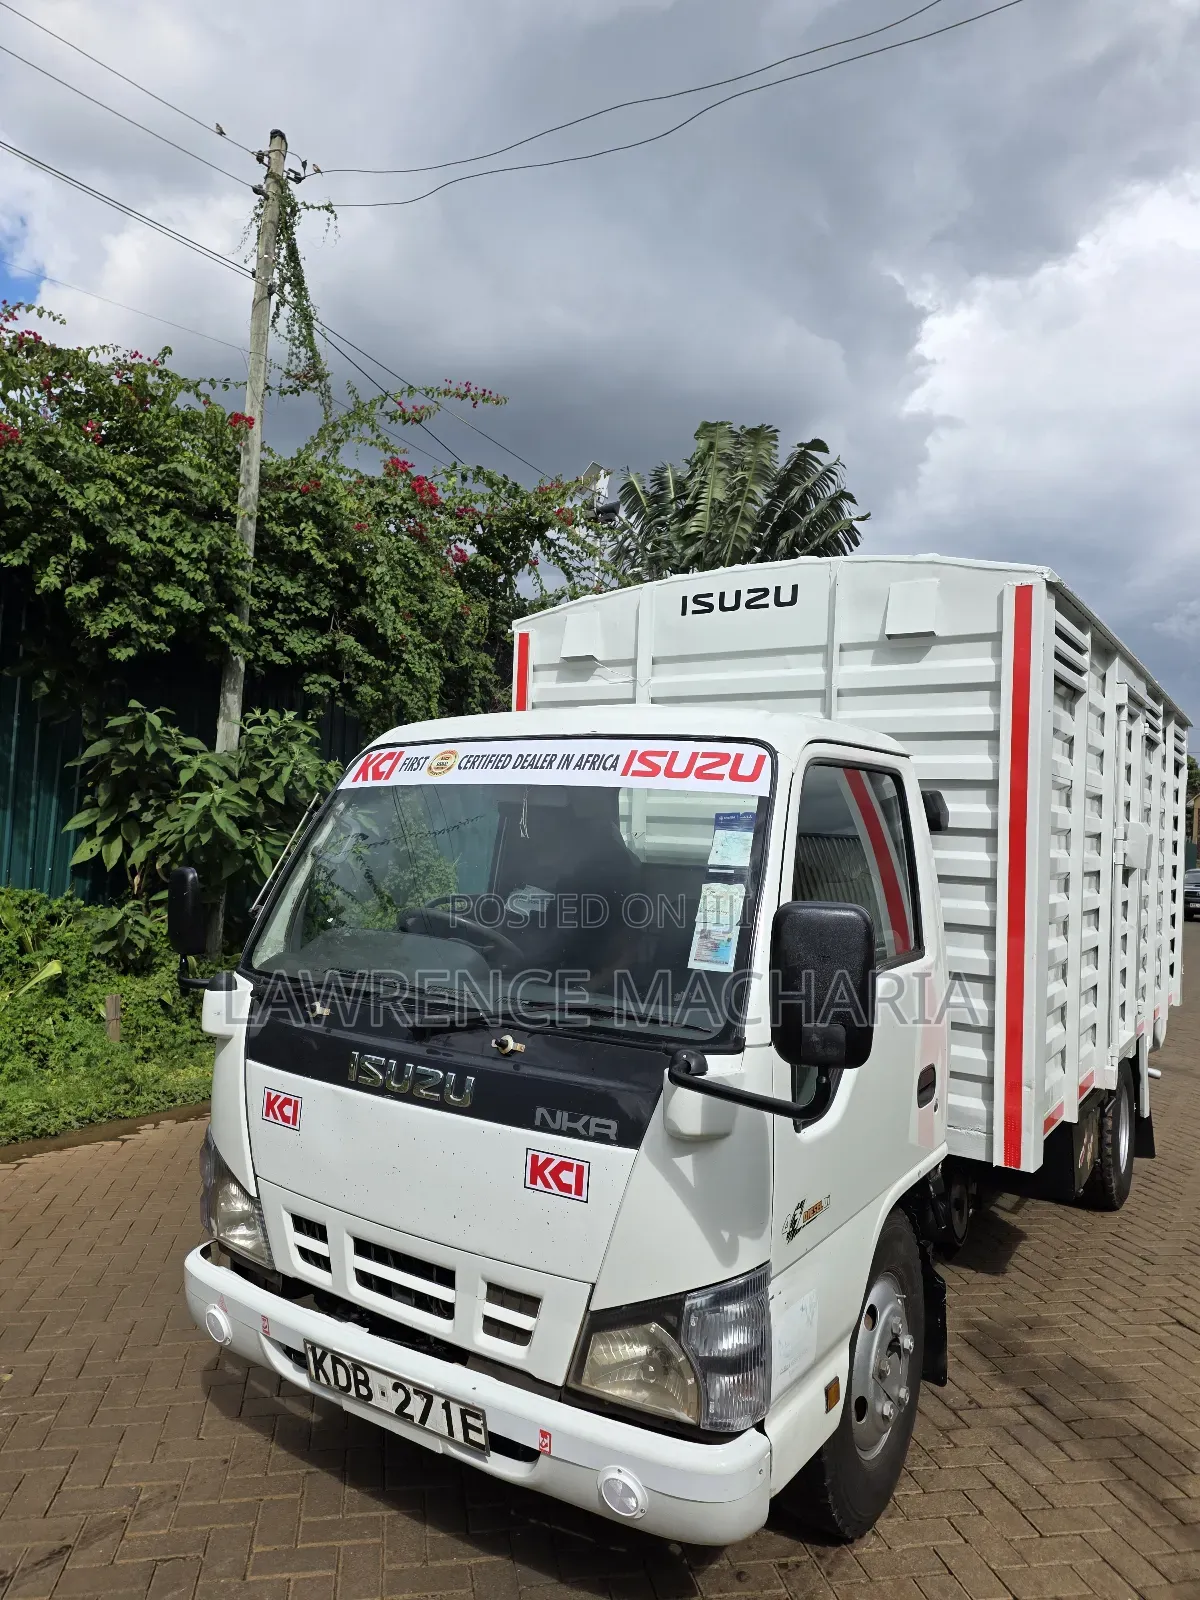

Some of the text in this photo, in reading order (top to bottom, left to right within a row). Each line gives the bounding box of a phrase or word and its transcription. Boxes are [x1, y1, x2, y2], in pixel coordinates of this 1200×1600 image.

[681, 584, 799, 616] ISUZU
[352, 751, 405, 782] KCI
[399, 756, 430, 772] FIRST
[458, 754, 513, 770] CERTIFIED
[507, 754, 555, 770] DEALER
[556, 754, 571, 770] IN
[573, 754, 621, 771] AFRICA
[620, 750, 766, 782] ISUZU
[348, 1051, 476, 1108] ISUZU
[264, 1091, 299, 1127] KCI
[535, 1106, 620, 1141] NKR
[529, 1154, 584, 1197] KCI
[309, 1345, 487, 1452] KDB 271E
